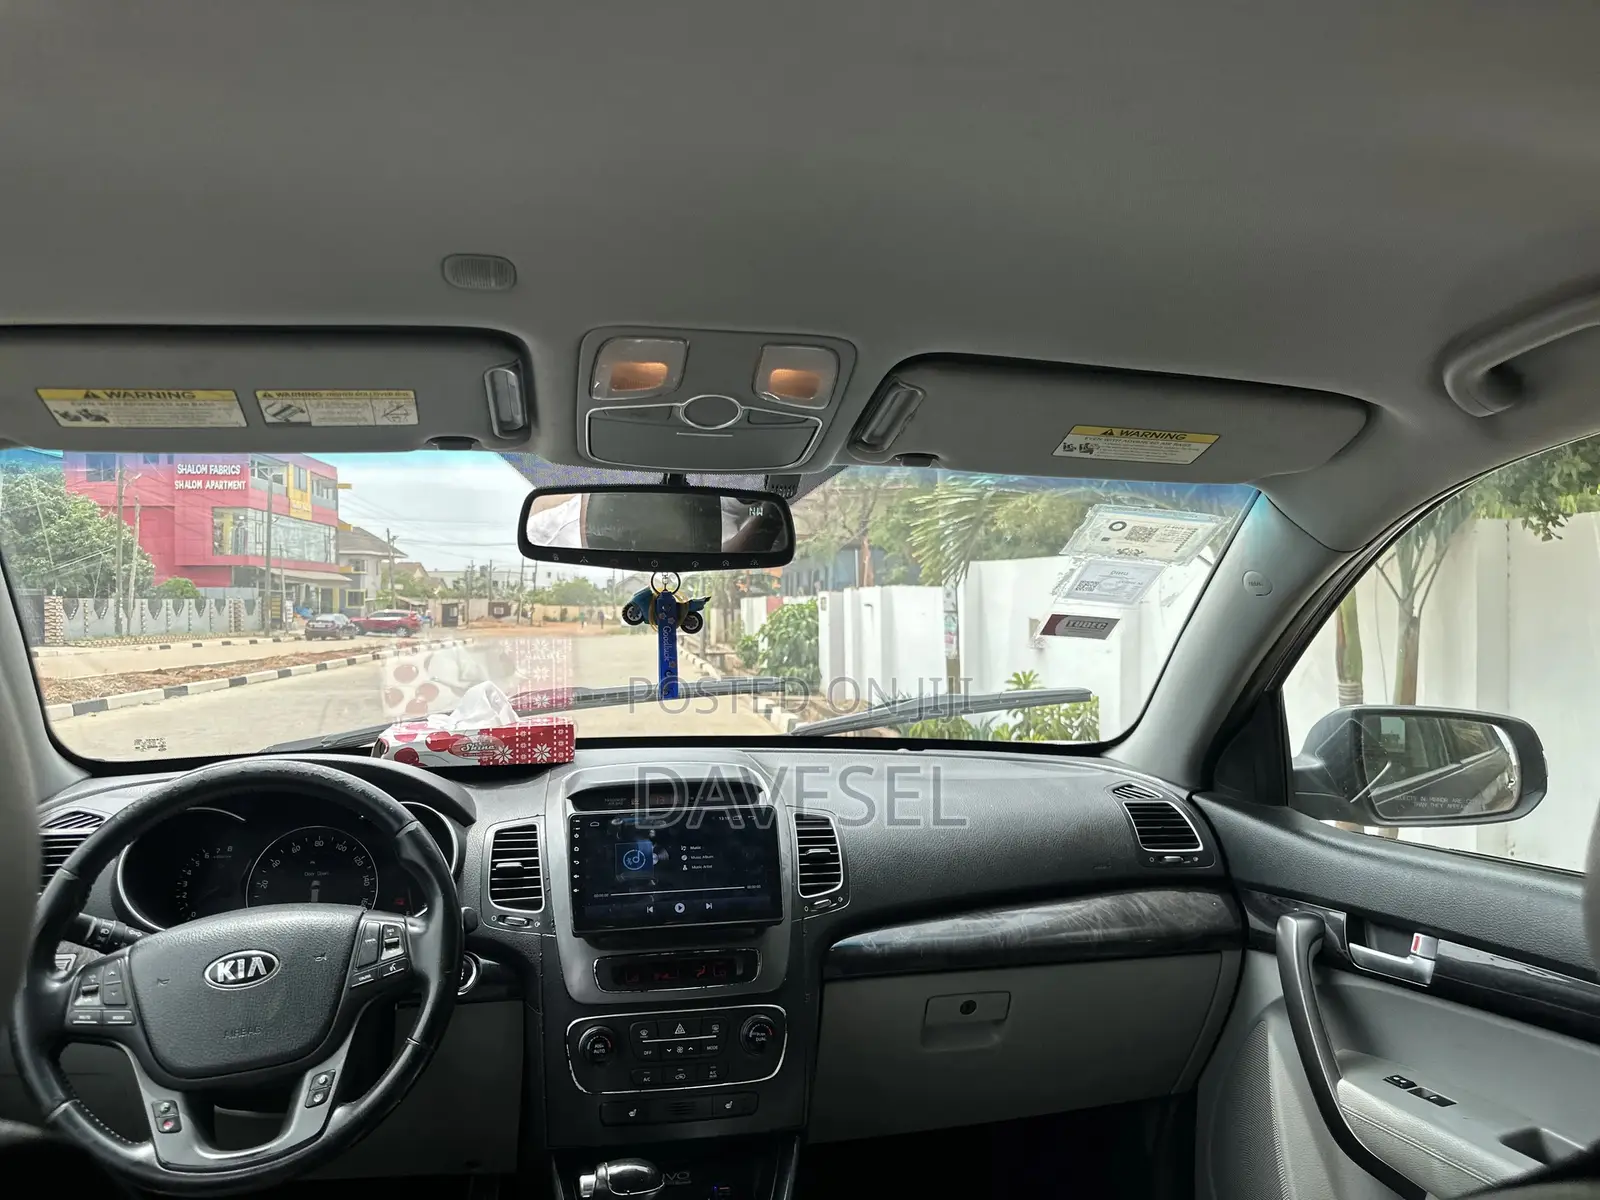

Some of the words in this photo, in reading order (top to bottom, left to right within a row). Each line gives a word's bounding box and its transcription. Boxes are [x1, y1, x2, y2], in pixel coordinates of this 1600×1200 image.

[103, 391, 196, 399] WARNING
[1119, 429, 1187, 441] WARNING
[177, 463, 208, 475] SHALOM
[209, 464, 241, 475] FABRICS
[174, 480, 203, 490] SHALOM
[205, 480, 247, 490] APARTMENT
[749, 506, 764, 517] NW
[460, 743, 497, 752] Shine
[291, 845, 301, 854] 60
[335, 843, 348, 852] 100
[272, 859, 281, 868] 40
[353, 855, 364, 867] 120
[260, 879, 269, 889] 20
[217, 956, 268, 983] KIA
